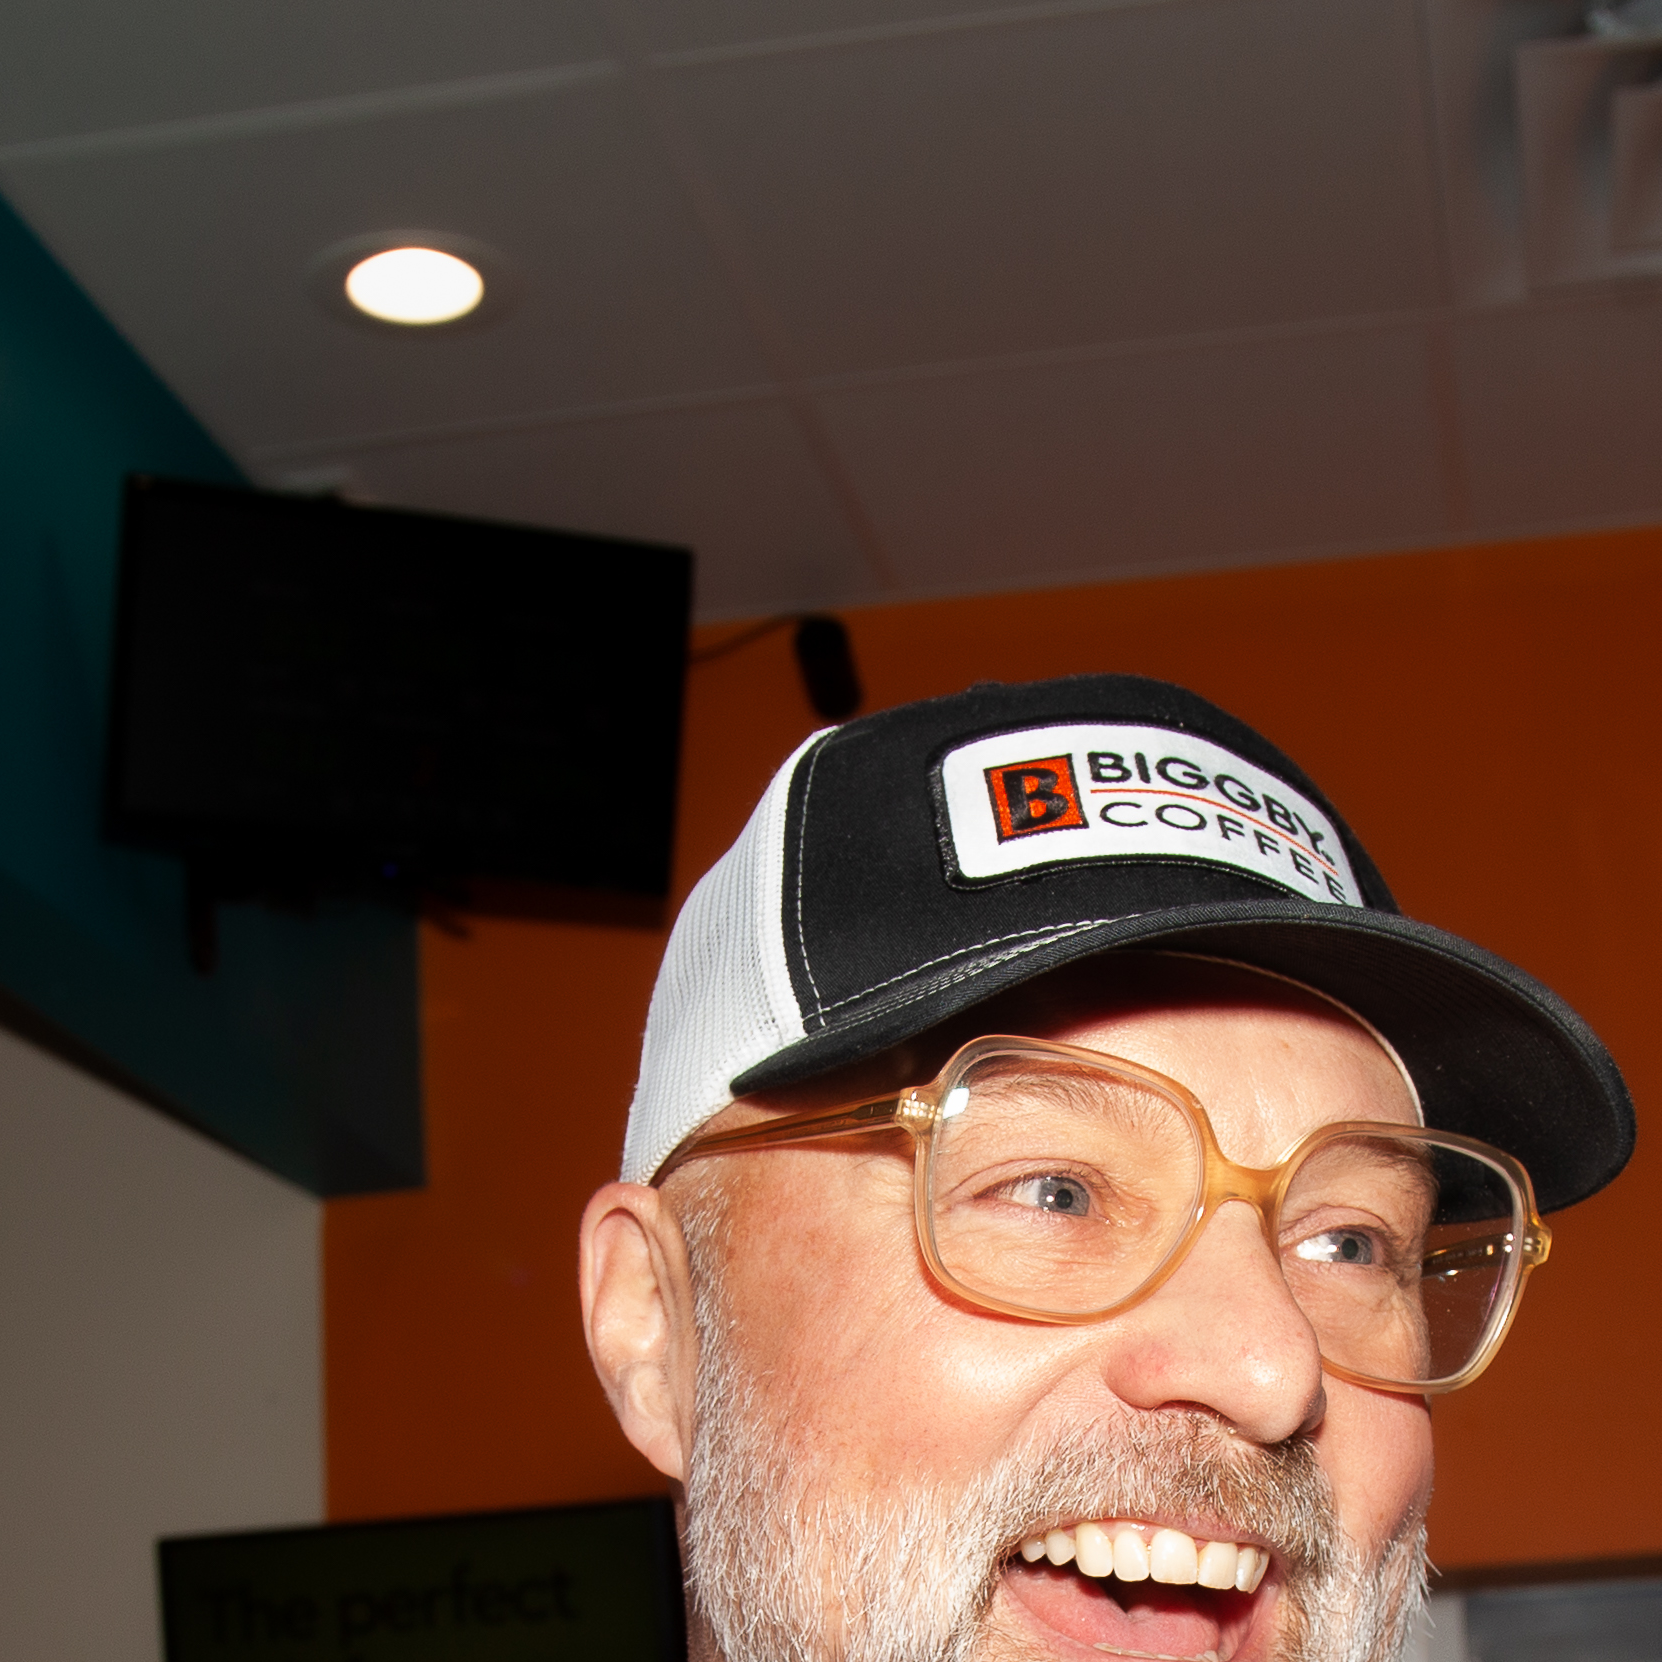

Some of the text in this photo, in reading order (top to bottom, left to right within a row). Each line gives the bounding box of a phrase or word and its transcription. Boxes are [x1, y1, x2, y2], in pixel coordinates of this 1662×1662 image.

[1002, 766, 1070, 832] B
[1099, 801, 1347, 905] COFFEE
[198, 1562, 578, 1647] The perfect
